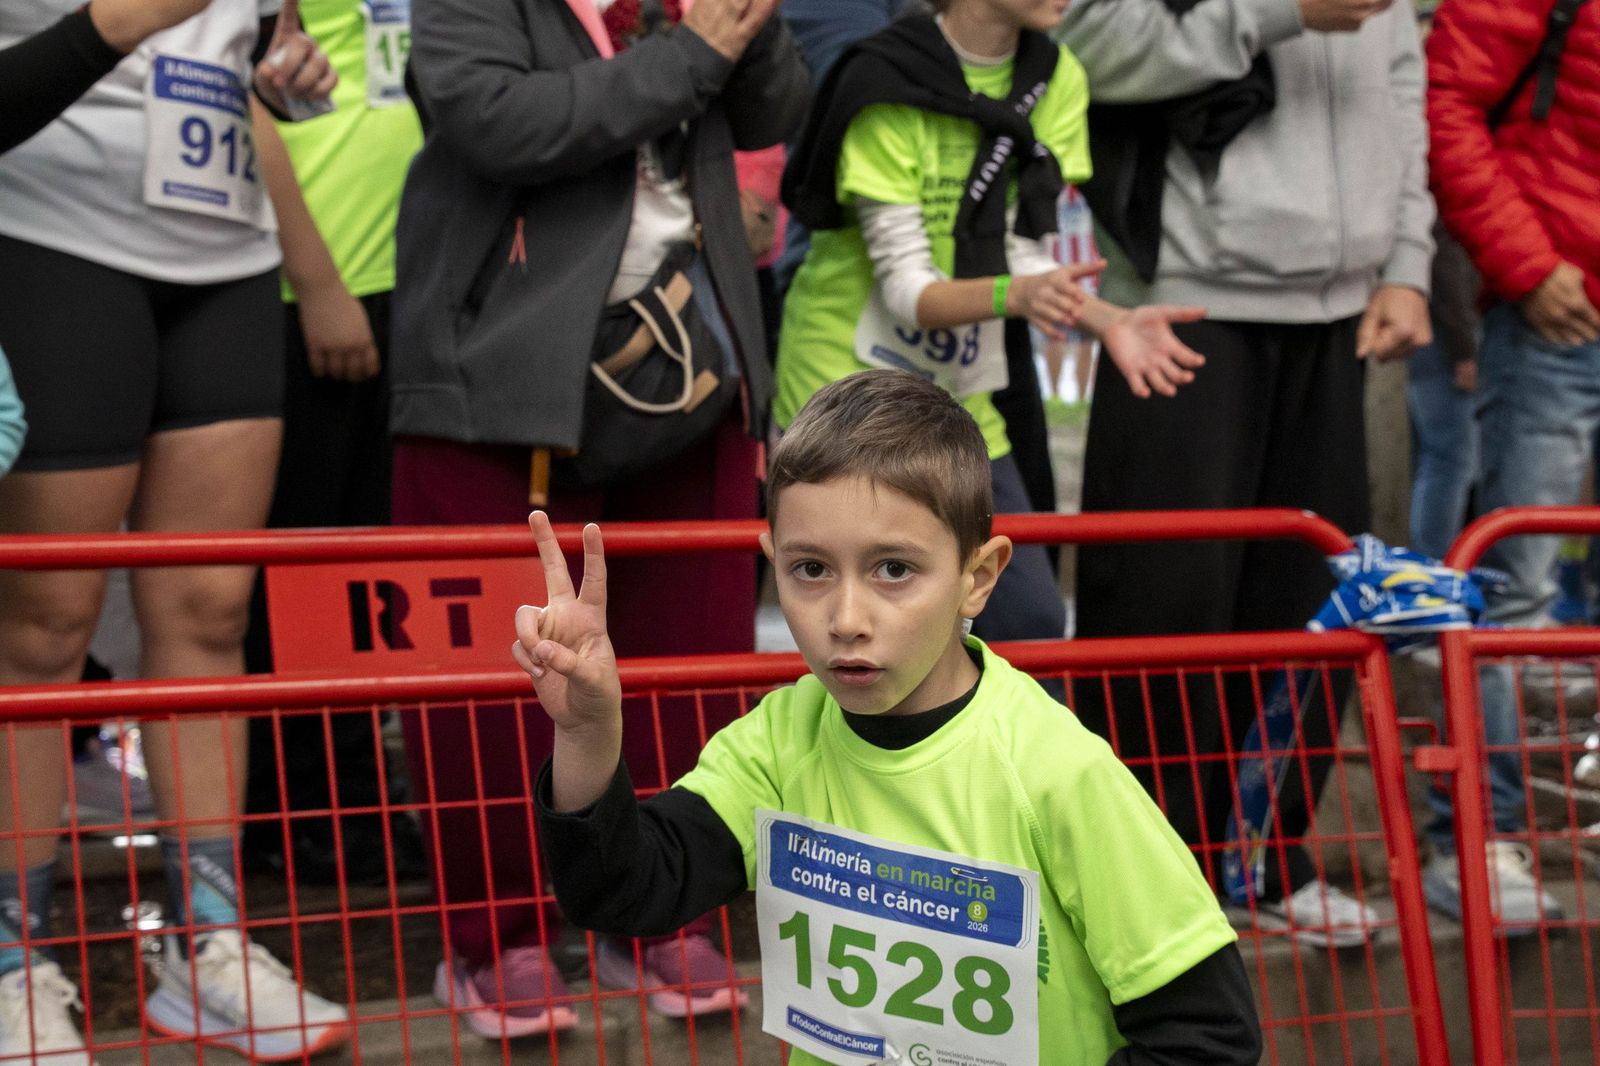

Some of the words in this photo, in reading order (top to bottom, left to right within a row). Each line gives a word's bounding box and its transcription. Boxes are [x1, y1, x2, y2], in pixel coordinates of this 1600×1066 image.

[347, 577, 482, 652] RT
[791, 866, 851, 898] contra
[857, 884, 877, 904] el
[883, 891, 960, 922] cáncer
[876, 863, 903, 882] en
[910, 870, 996, 901] marcha
[967, 921, 989, 933] 2026
[973, 904, 982, 916] 8
[779, 910, 1014, 1036] 1528
